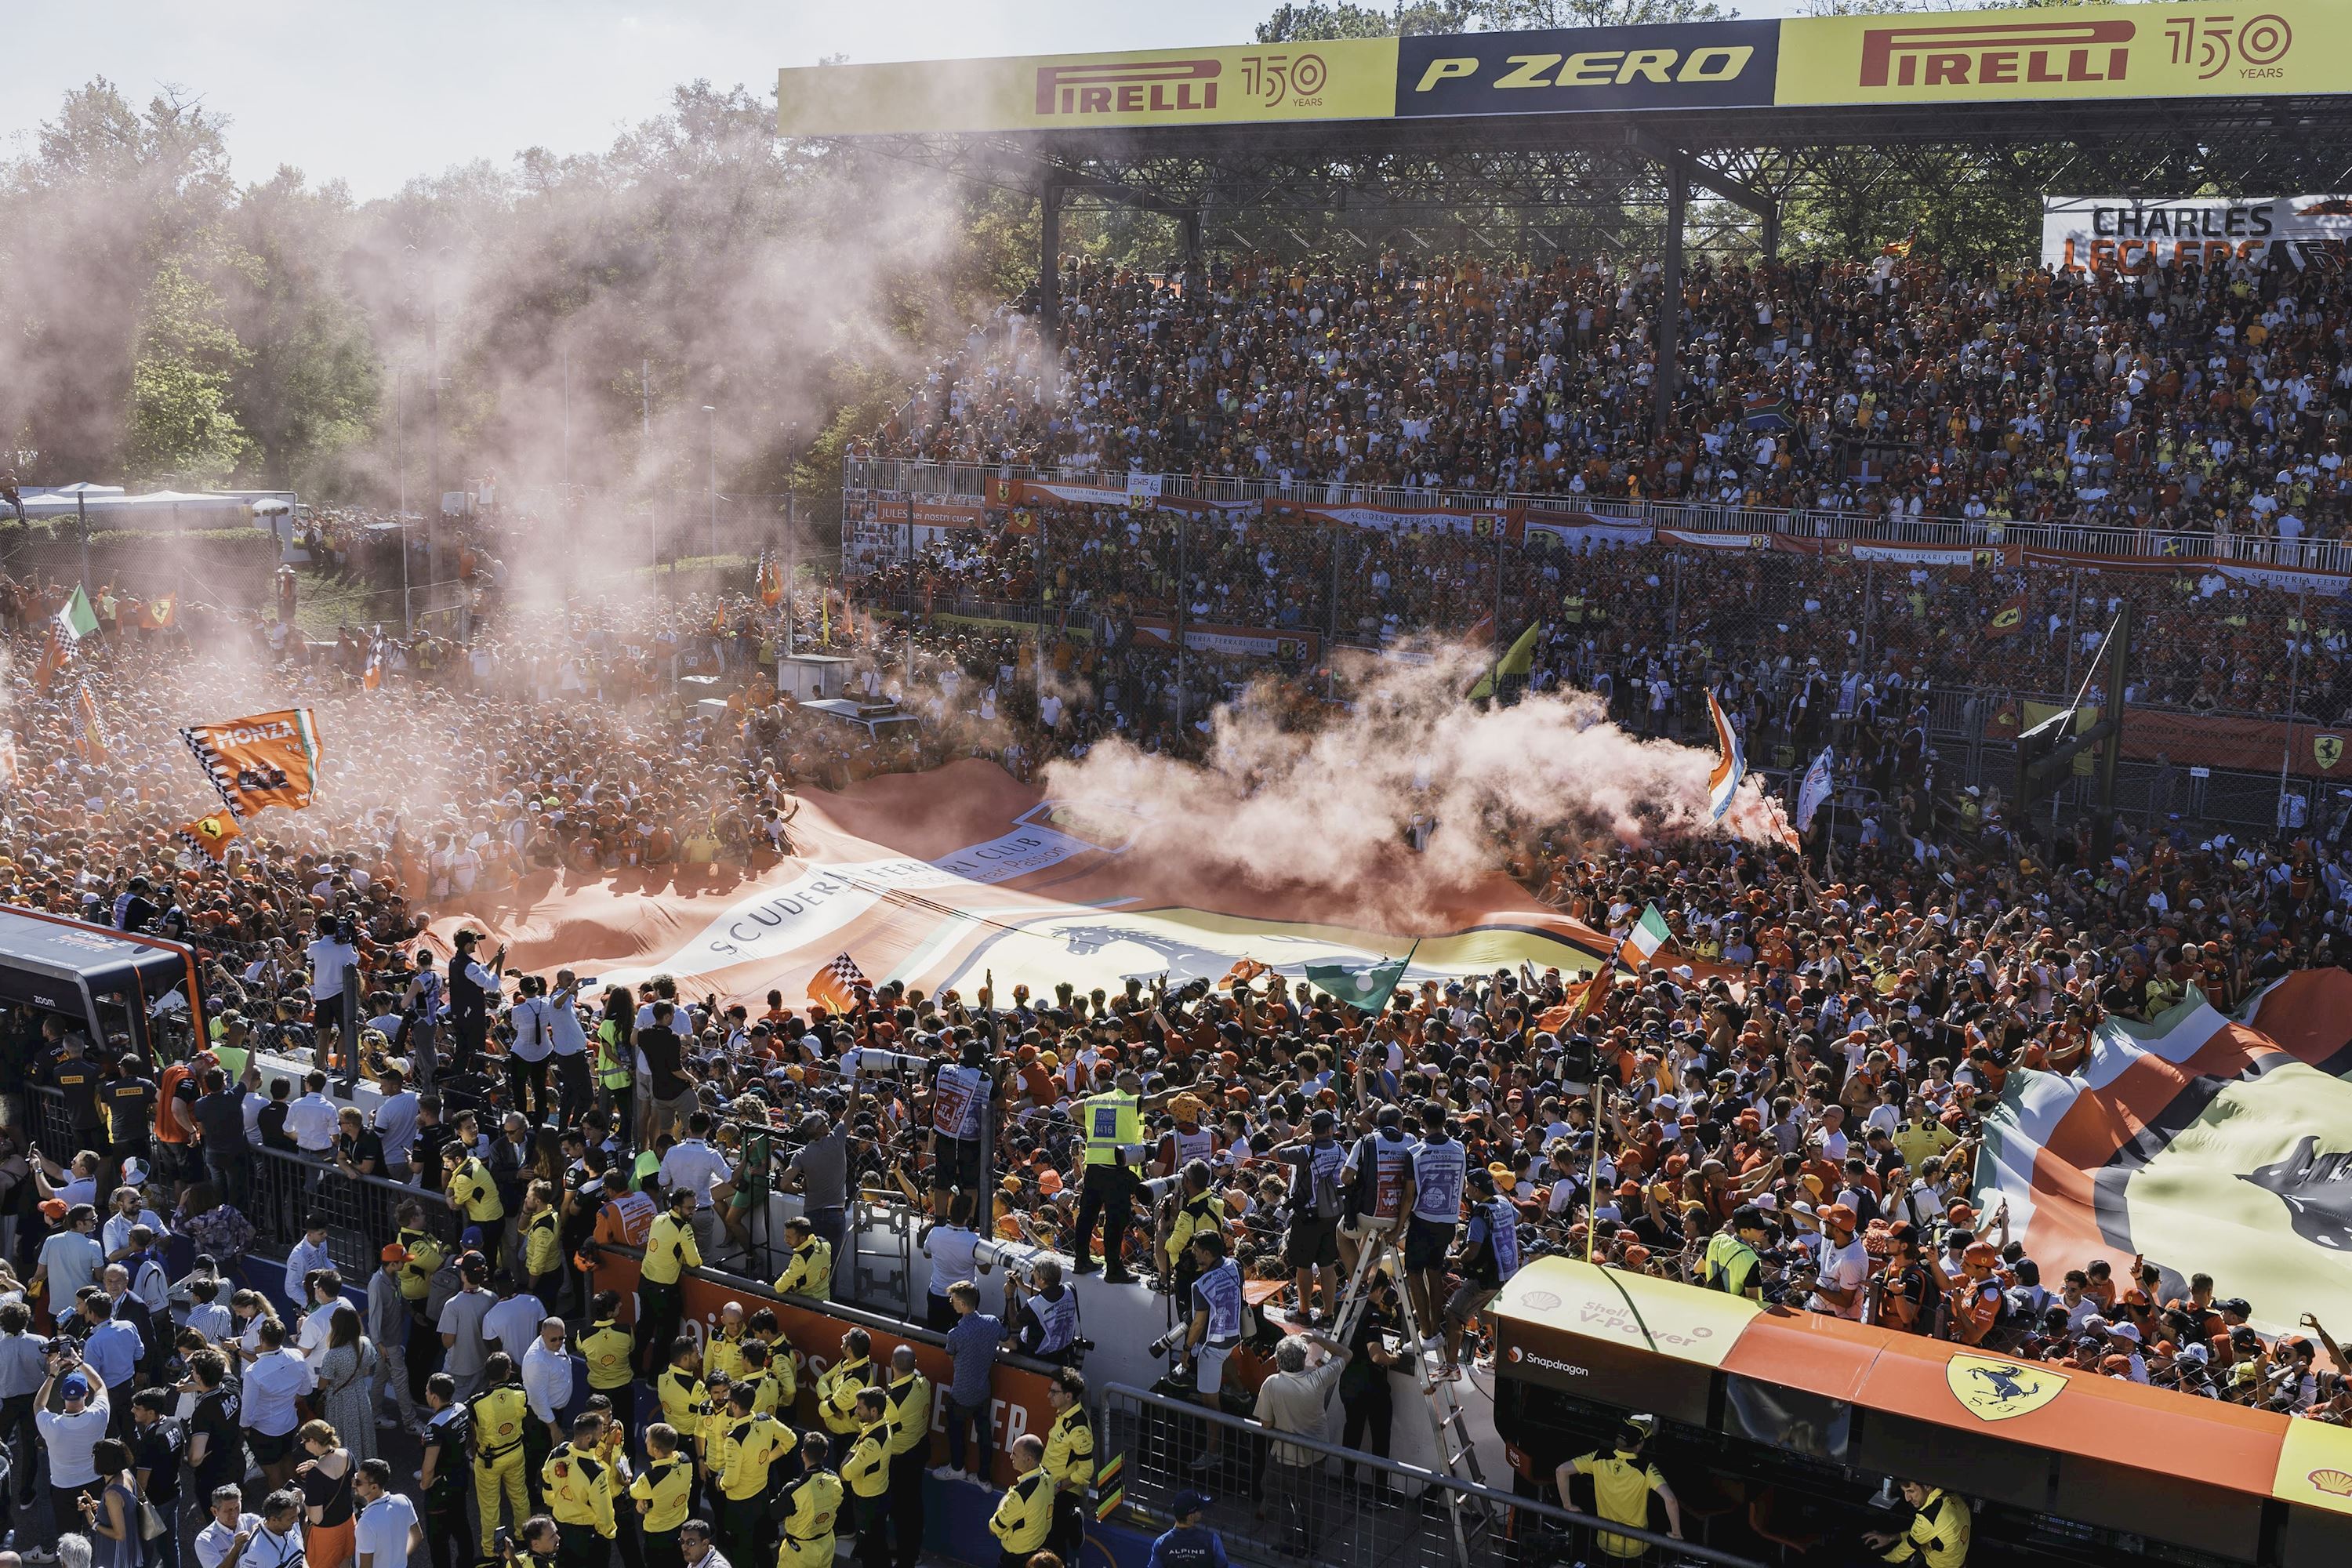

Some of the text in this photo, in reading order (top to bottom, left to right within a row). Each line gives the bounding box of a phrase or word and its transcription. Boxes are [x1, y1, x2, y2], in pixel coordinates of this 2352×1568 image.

[1860, 20, 2136, 87] PIRELLI
[2165, 14, 2292, 80] 150
[1416, 46, 1754, 92] P ZERO
[2238, 67, 2285, 79] YEARS
[1036, 60, 1221, 115] PIRELLI
[1242, 54, 1327, 107] 150
[1292, 97, 1323, 107] YEARS
[2092, 206, 2273, 237] CHARLES
[880, 507, 908, 519] JULES
[924, 510, 950, 521] nostri
[1350, 511, 1395, 523] SCUDERIA
[1860, 550, 1902, 559] SCUDERIA
[2251, 572, 2345, 586] SCUDERIA FERR
[1215, 637, 1247, 647] FERRARI
[1250, 640, 1272, 648] CLUB
[212, 720, 297, 750] MONZA
[975, 837, 1042, 860] CLUB
[1003, 847, 1071, 869] Passion
[34, 995, 56, 1007] zoom
[1095, 1125, 1112, 1134] 0416
[1382, 1197, 1398, 1206] WA
[1583, 1301, 1630, 1318] Shell
[1580, 1309, 1697, 1347] V-Power
[1526, 1352, 1588, 1377] Snapdragon
